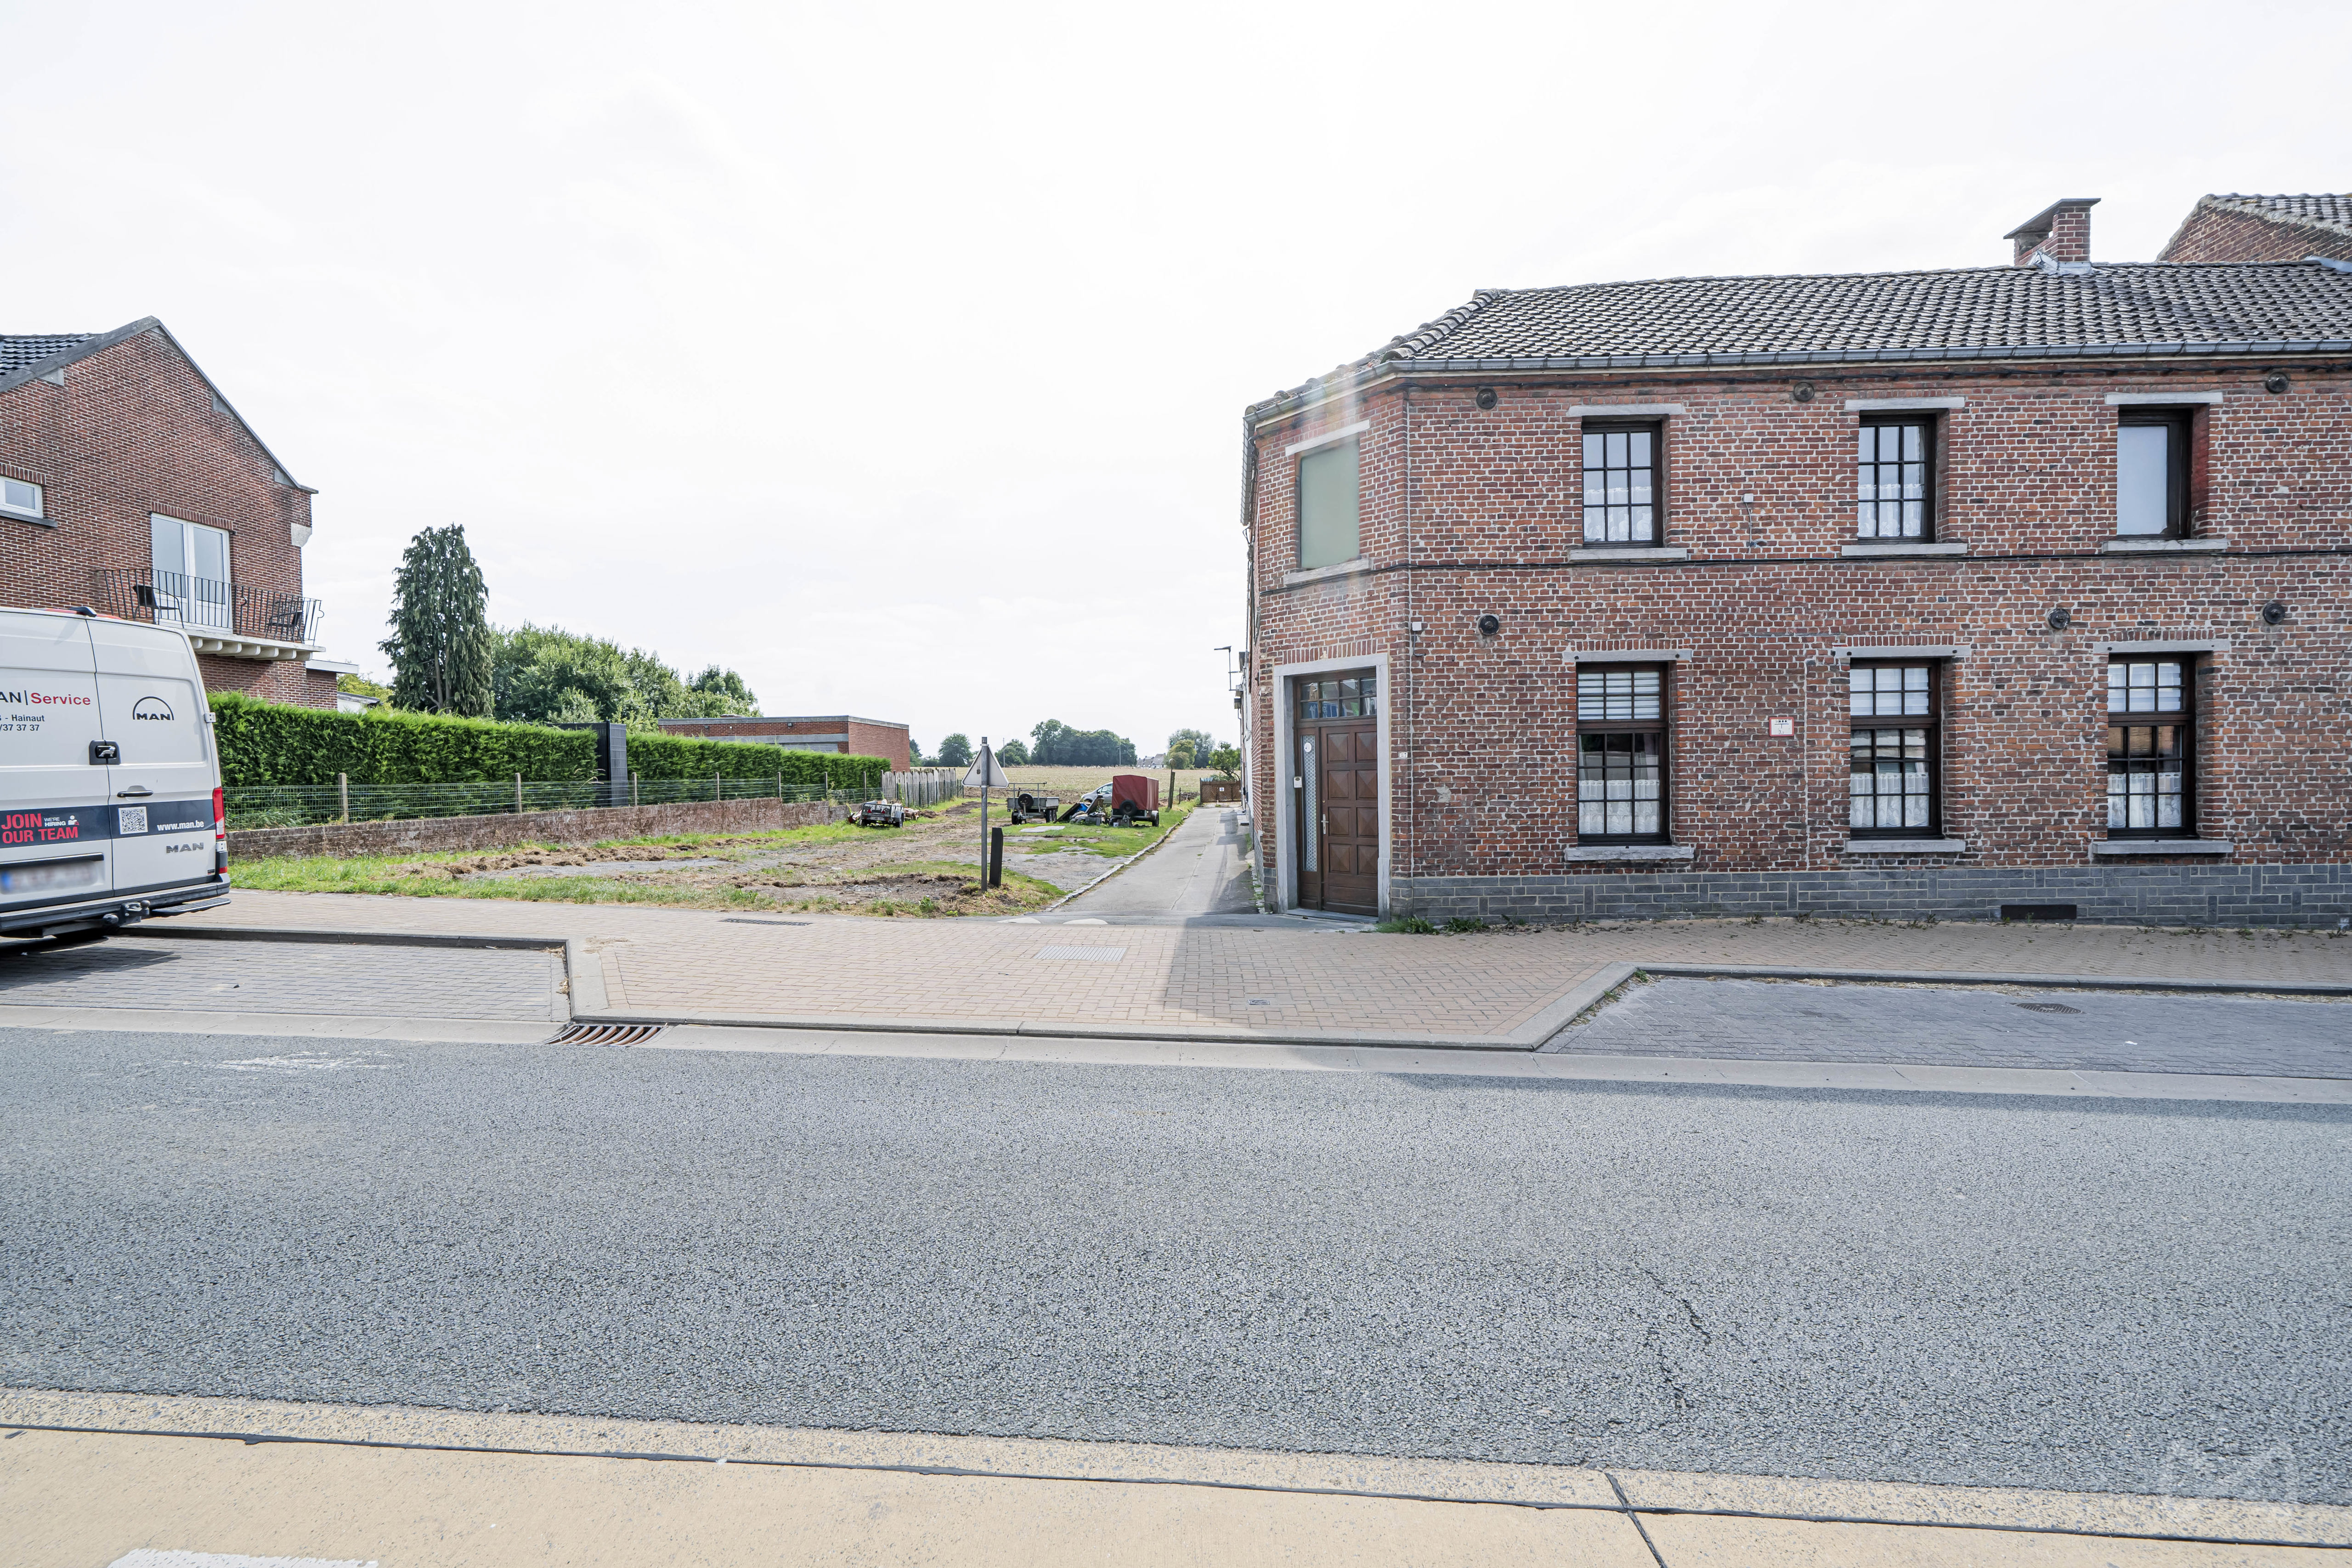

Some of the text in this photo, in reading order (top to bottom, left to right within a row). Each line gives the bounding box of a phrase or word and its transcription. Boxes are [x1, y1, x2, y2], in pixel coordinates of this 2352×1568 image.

[31, 693, 91, 705] Service
[1, 813, 42, 830] JOIN
[157, 820, 204, 831] www.man.be
[2, 826, 78, 843] OUR TEAM
[166, 842, 204, 854] MAN
